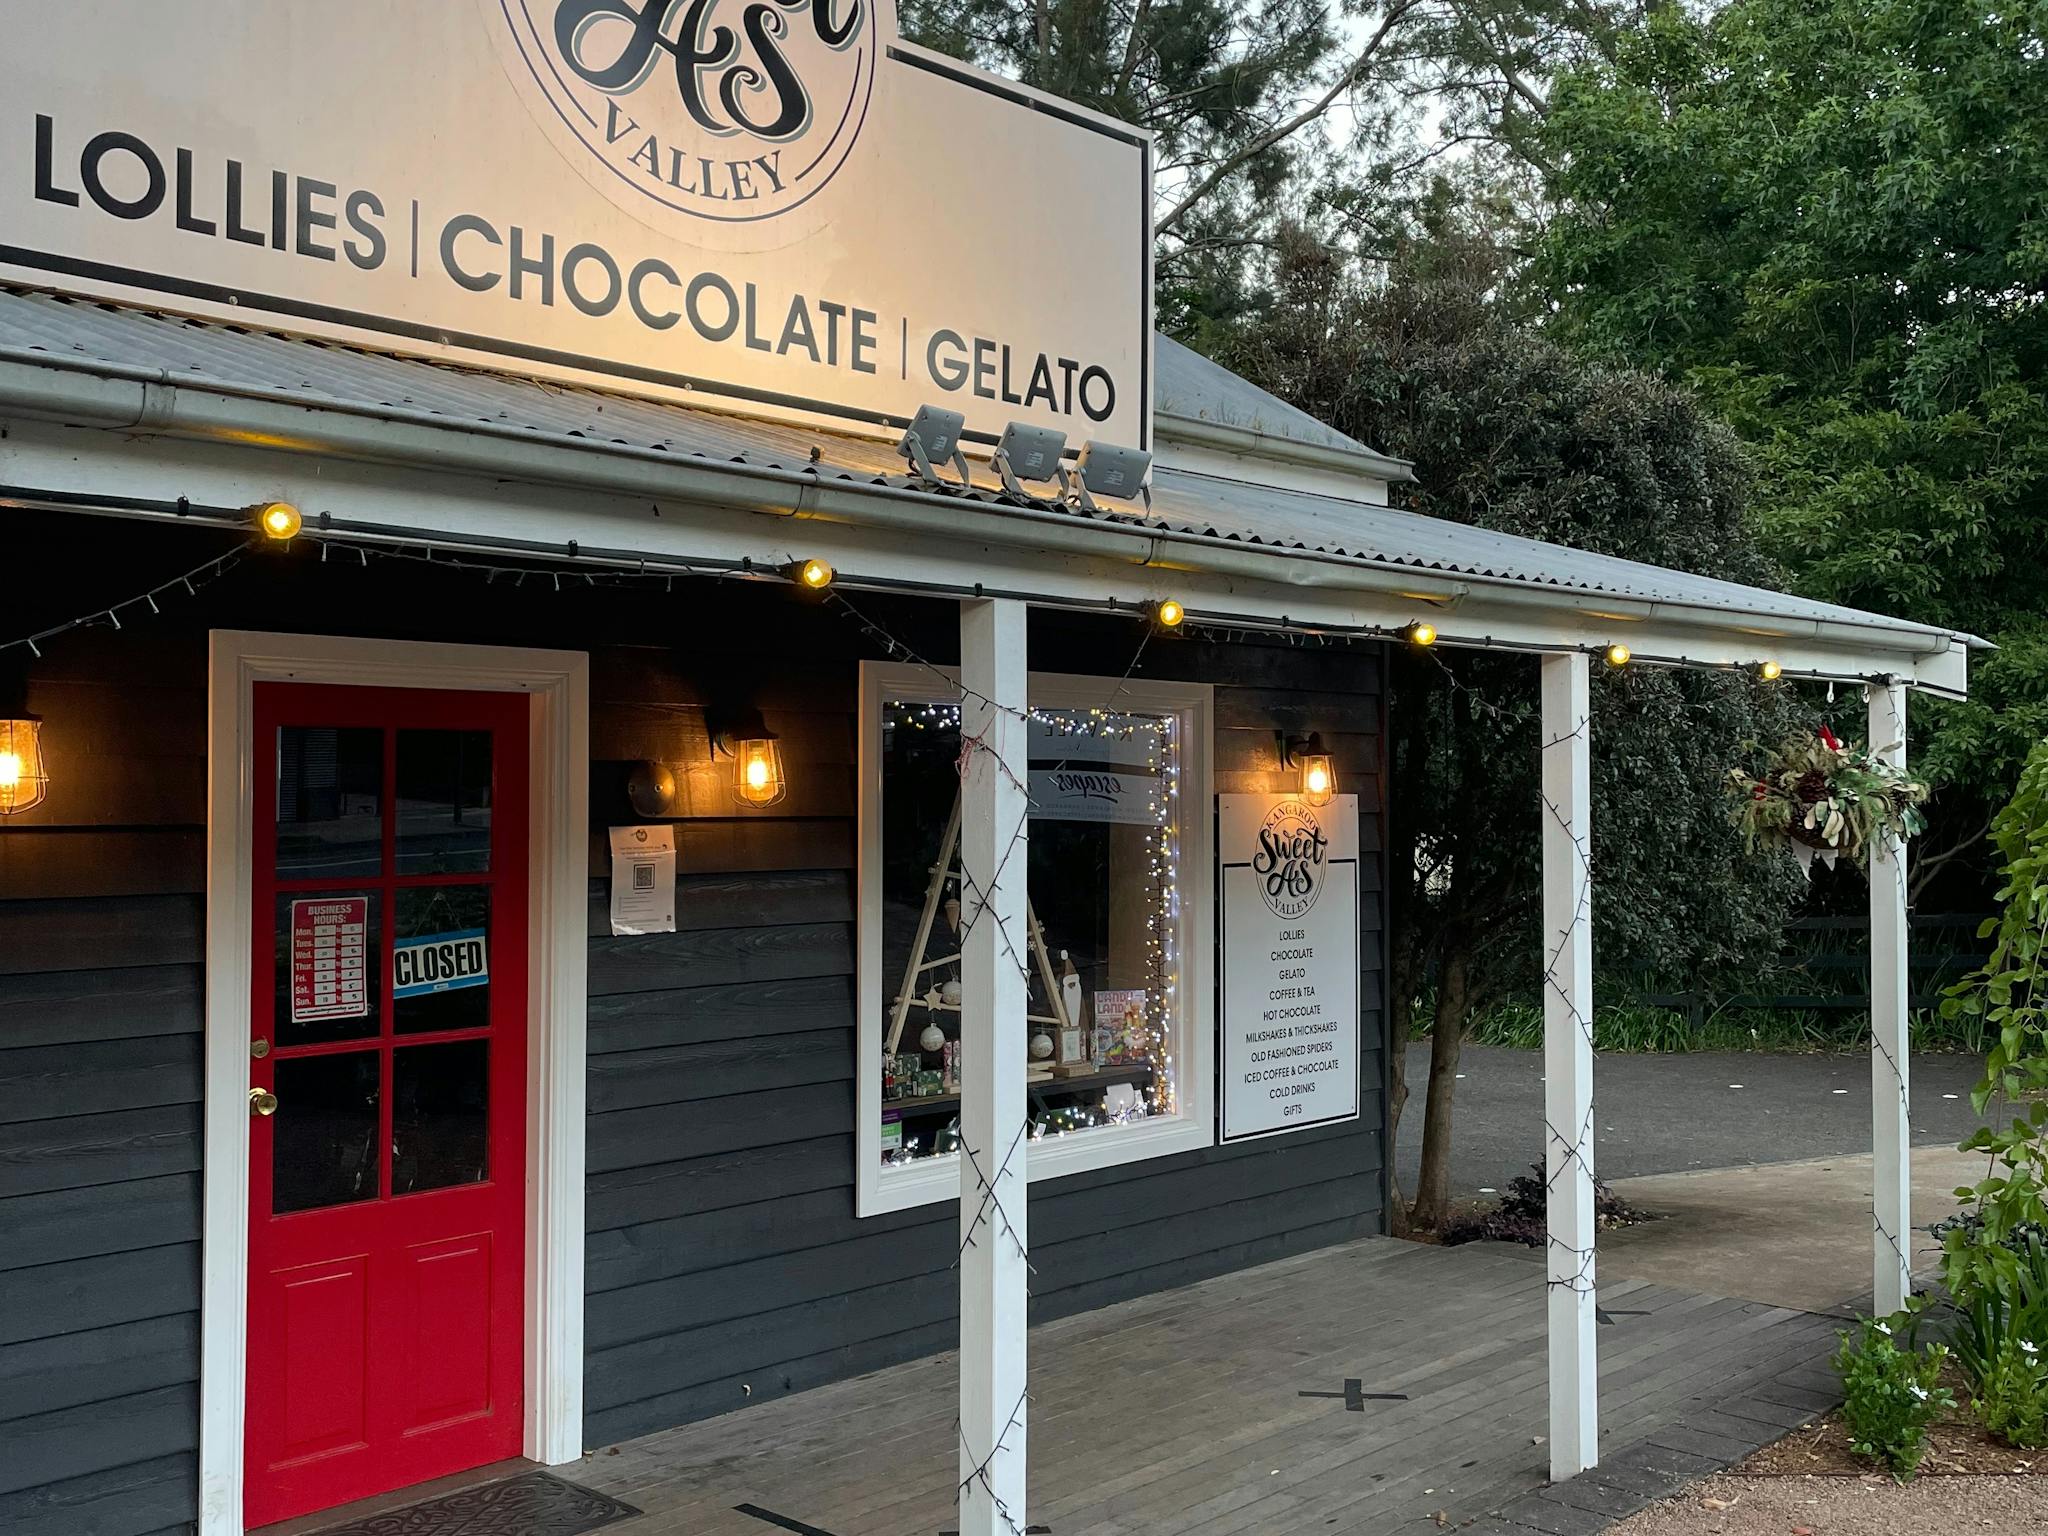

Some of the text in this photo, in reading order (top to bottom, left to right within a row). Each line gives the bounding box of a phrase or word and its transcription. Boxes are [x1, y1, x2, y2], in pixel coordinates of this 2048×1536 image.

[602, 97, 786, 201] VALLEY
[34, 114, 1116, 424] LOLLIES CHOCOLATE GELATO
[1266, 805, 1318, 830] KANGAROO
[1253, 828, 1327, 874] Sweet
[308, 905, 352, 915] BUSINESS
[1275, 898, 1309, 914] VALLEY
[314, 914, 347, 924] HOURS:
[296, 927, 313, 937] Mon.
[1279, 929, 1305, 941] LOLLIES
[296, 939, 313, 948] Tues.
[296, 951, 313, 960] Wed.
[1271, 948, 1313, 961] CHOCOLATE
[296, 962, 313, 972] Thur.
[395, 941, 482, 986] CLOSED
[296, 974, 307, 983] Fri.
[1279, 967, 1306, 980] GELATO
[296, 986, 309, 995] Sat.
[1269, 986, 1315, 1001] COFFEE & TEA
[296, 997, 311, 1006] Sun.
[1097, 991, 1133, 1004] CANDY
[1097, 1004, 1124, 1014] LAND
[1263, 1004, 1321, 1021] HOT CHOCOLATE
[1245, 1021, 1338, 1044] MILKSHAKES & THICKSHAKES
[1251, 1041, 1333, 1063] OLD FASHIONED SPIDERS
[1244, 1059, 1339, 1084] ICED COFFEE & CHOCOLATE
[1269, 1082, 1316, 1099] COLD DRINKS
[1283, 1104, 1302, 1117] GIFTS
